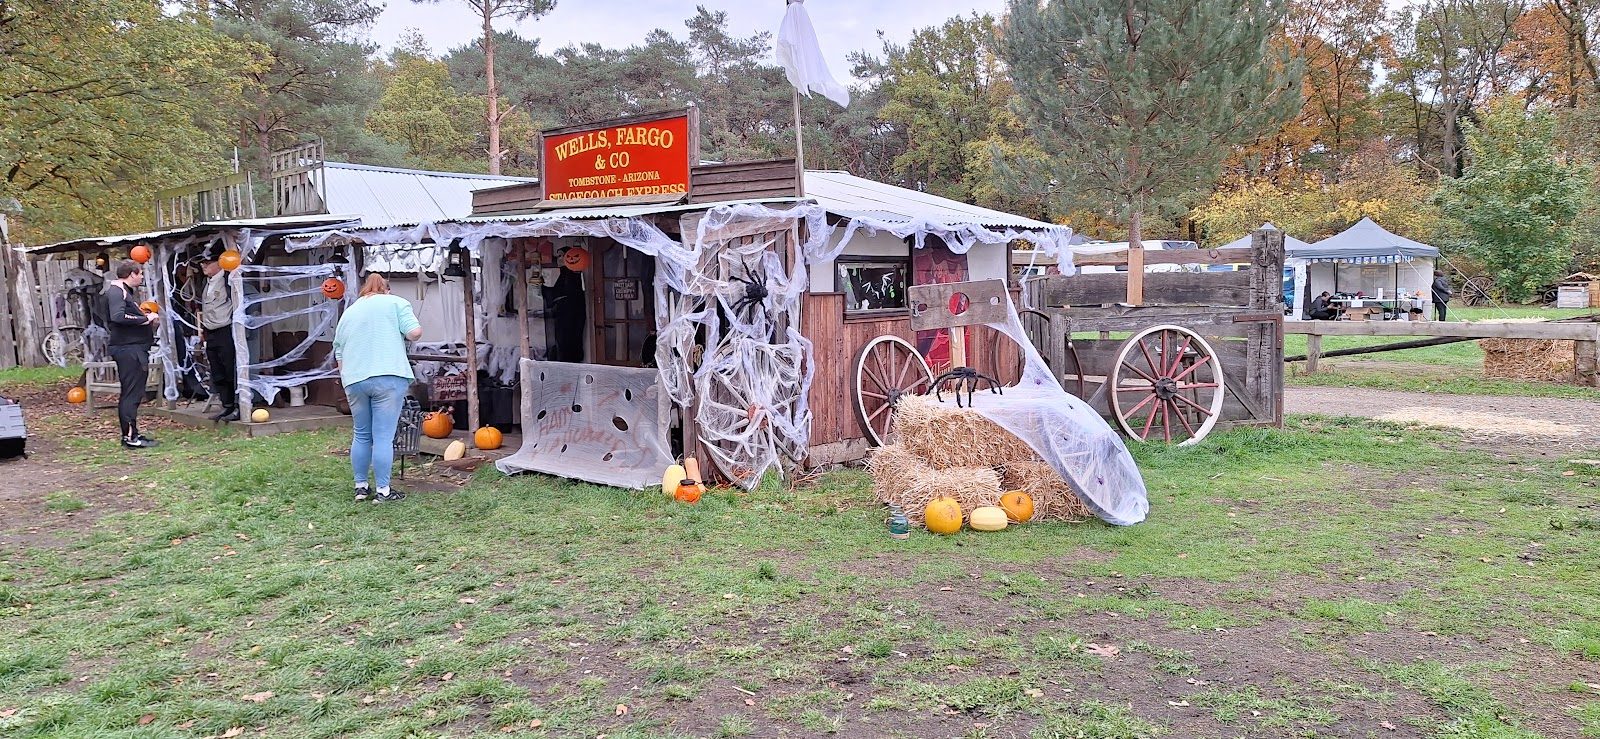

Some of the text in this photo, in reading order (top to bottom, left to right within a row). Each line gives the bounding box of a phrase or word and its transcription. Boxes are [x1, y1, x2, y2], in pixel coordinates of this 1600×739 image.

[555, 127, 674, 162] WELLS, FARGO
[594, 152, 630, 170] & CO
[568, 175, 617, 188] TOMBSTONE
[622, 171, 661, 183] ARIZONA
[549, 183, 686, 201] STAGECOACH EXPRESS
[435, 378, 466, 389] BUTCHER
